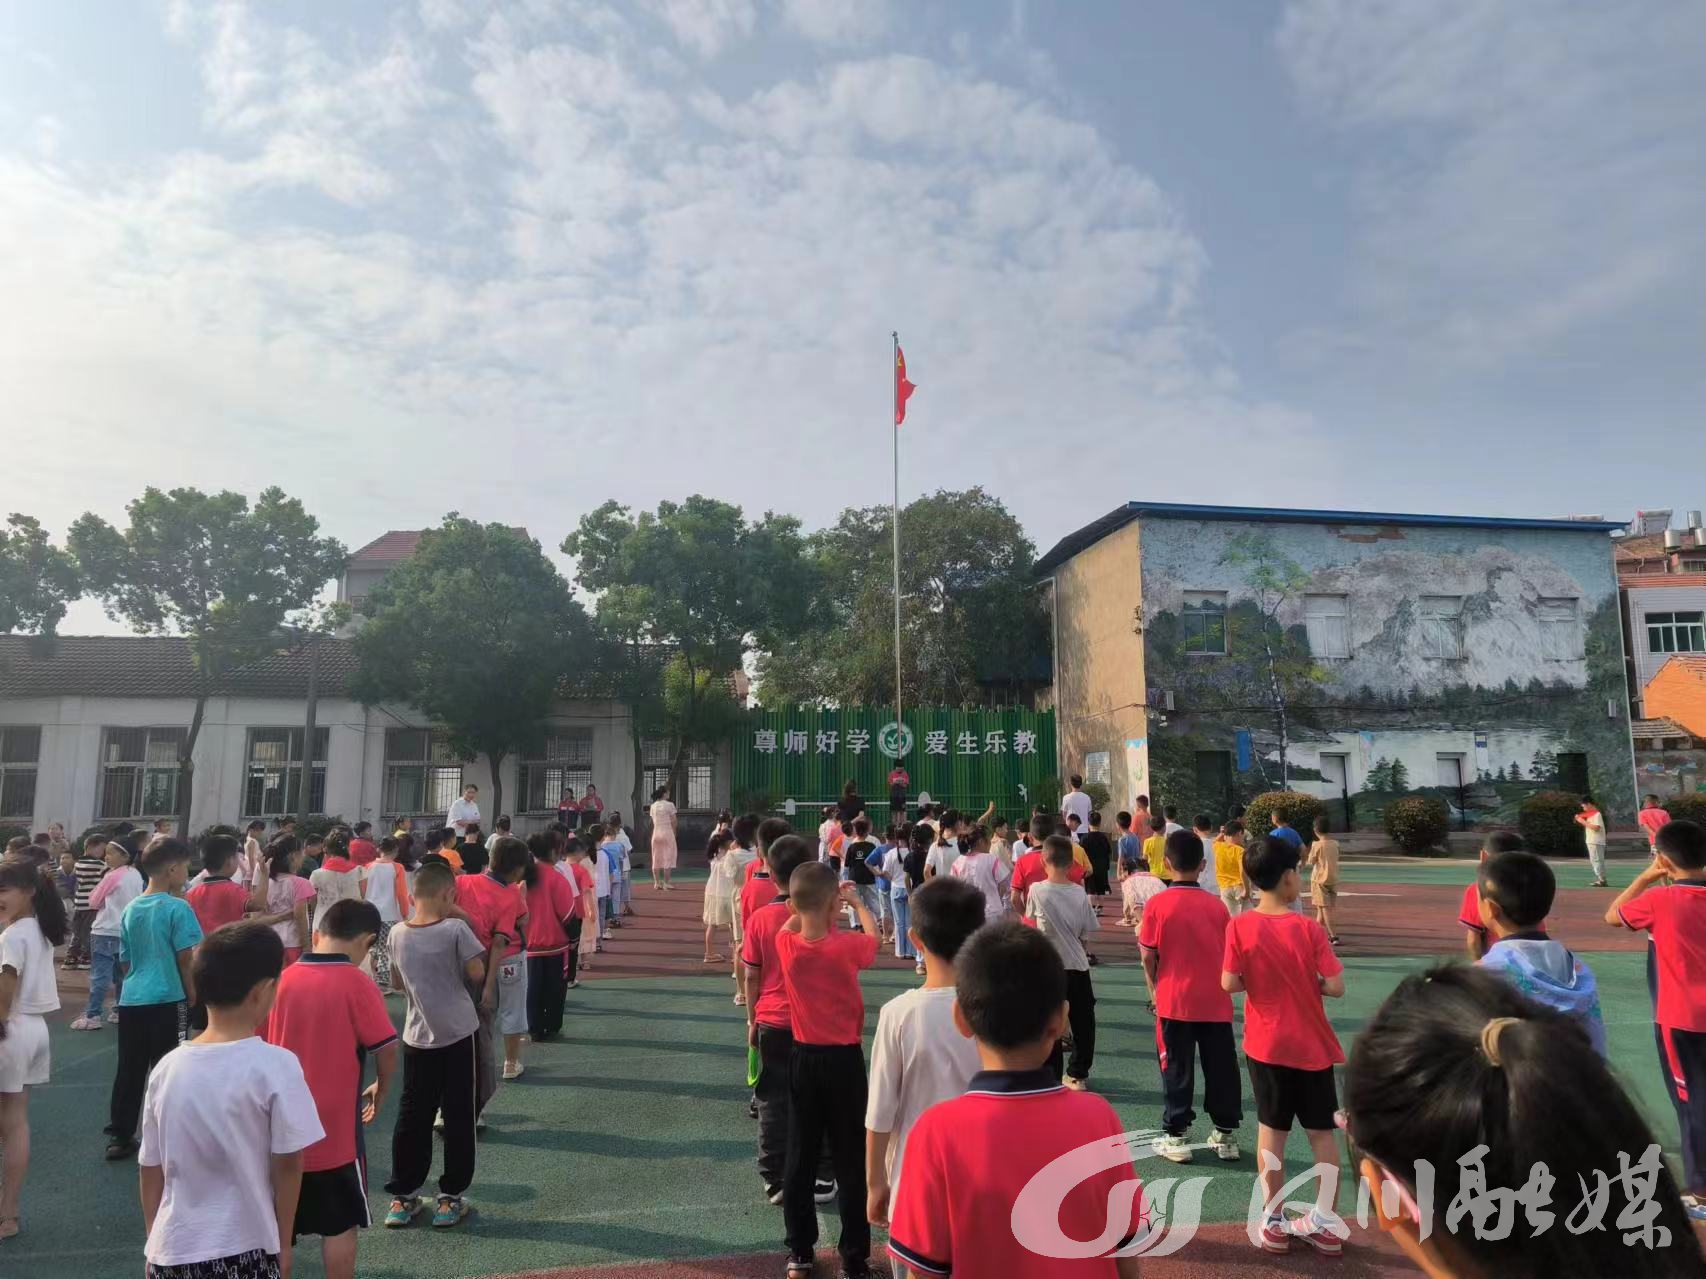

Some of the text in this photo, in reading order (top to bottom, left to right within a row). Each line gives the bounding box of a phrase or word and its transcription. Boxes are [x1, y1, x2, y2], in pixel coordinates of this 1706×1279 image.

[753, 728, 870, 755] 尊师好学
[924, 729, 1037, 755] 爱生乐教
